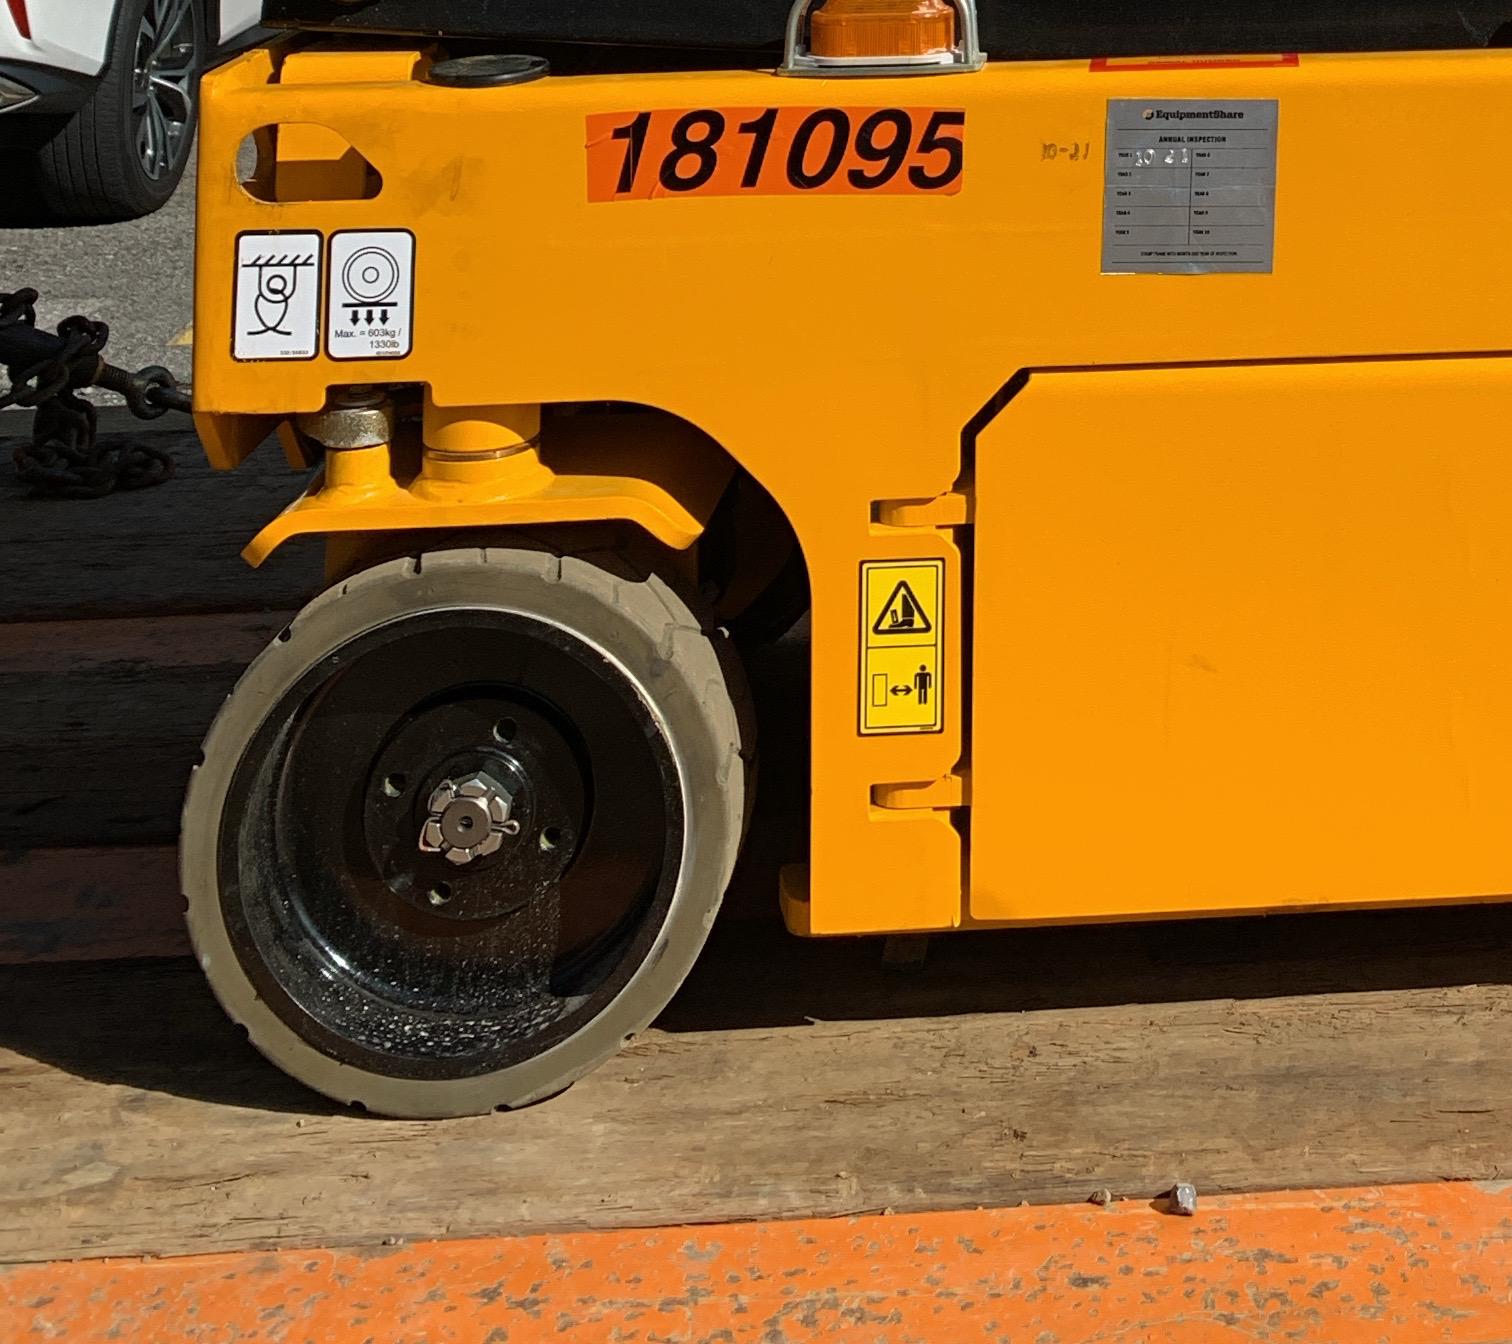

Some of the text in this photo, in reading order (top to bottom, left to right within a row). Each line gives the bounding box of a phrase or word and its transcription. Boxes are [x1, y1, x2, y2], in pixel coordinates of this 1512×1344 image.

[1155, 109, 1245, 121] EquipmentShare
[1158, 135, 1227, 144] ANNUAL INSPECTION
[612, 108, 966, 194] 181095
[335, 330, 356, 338] Max.
[370, 340, 399, 349] 1330lb
